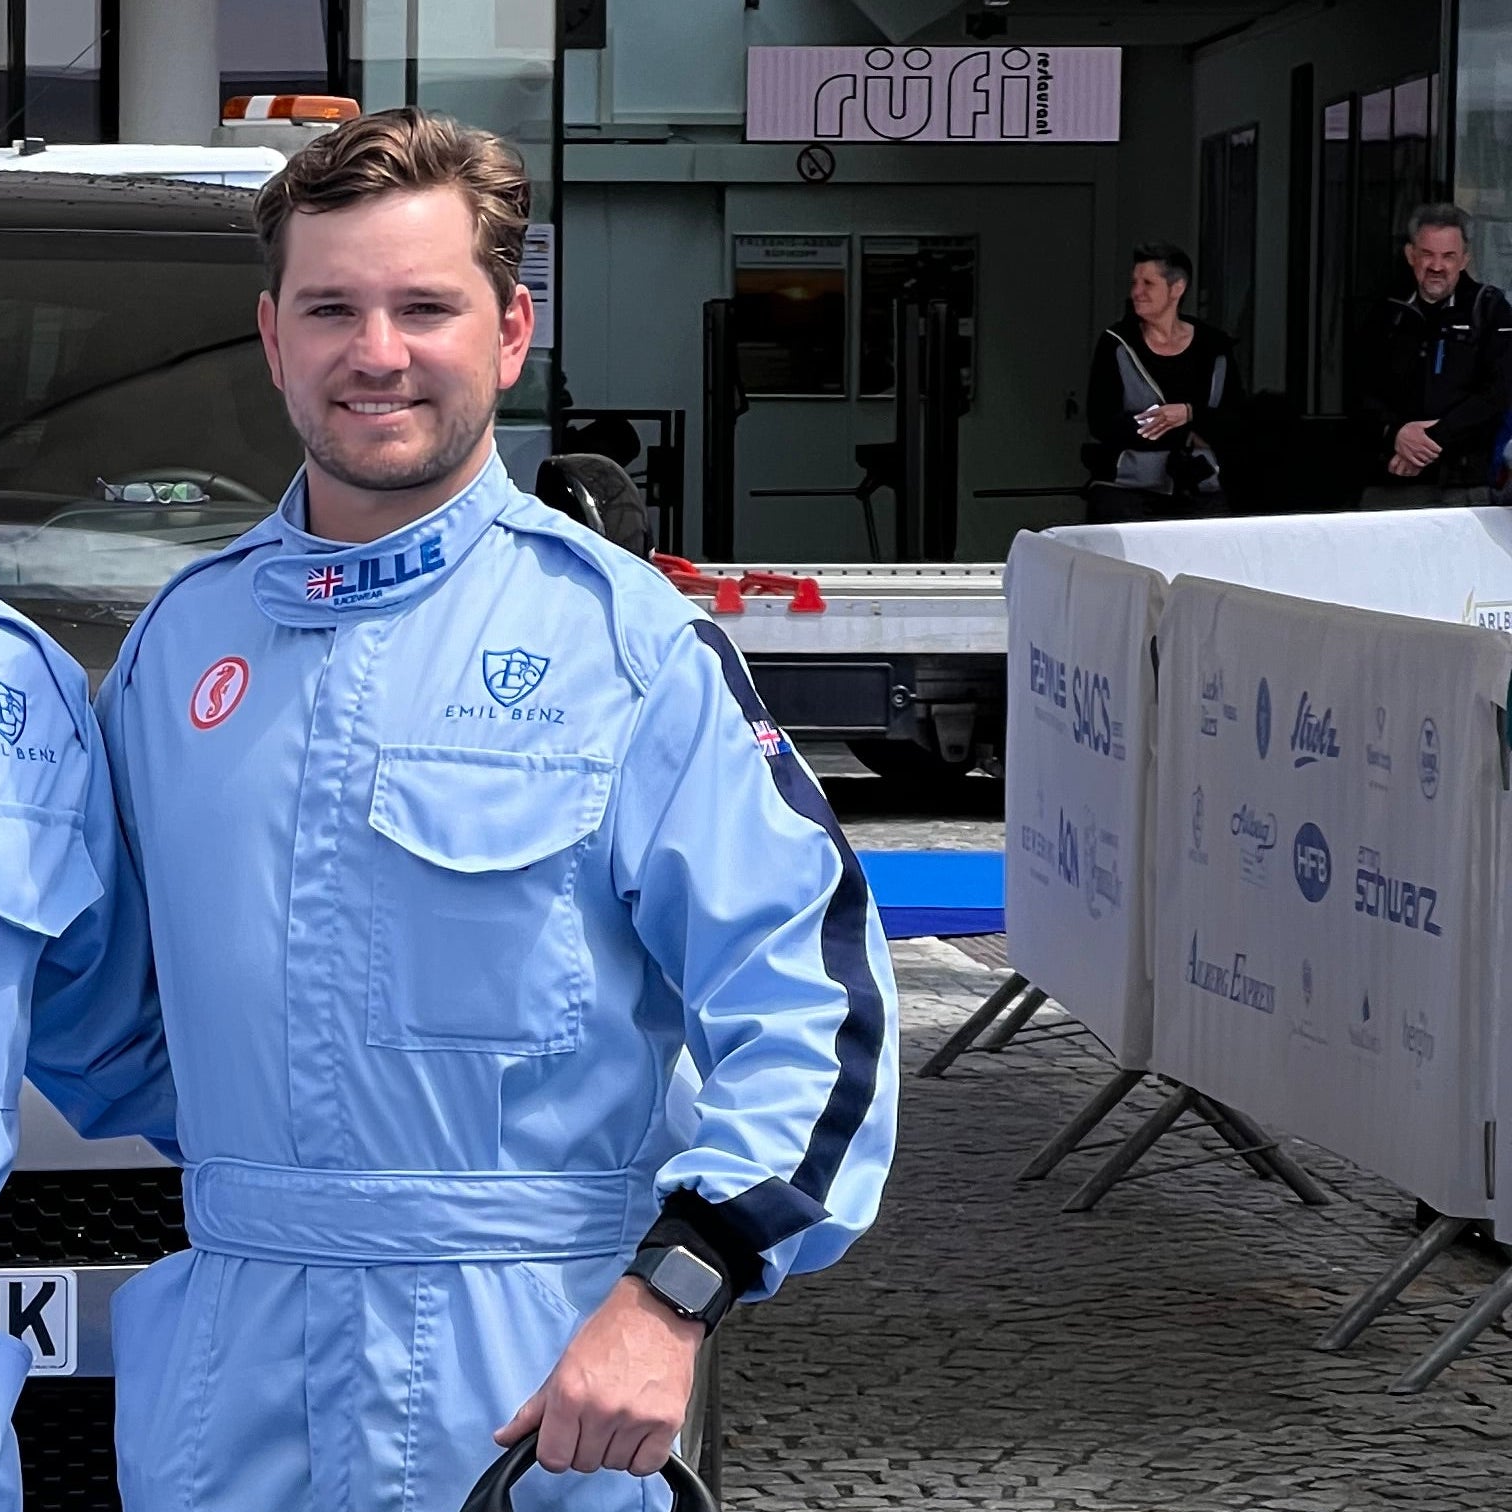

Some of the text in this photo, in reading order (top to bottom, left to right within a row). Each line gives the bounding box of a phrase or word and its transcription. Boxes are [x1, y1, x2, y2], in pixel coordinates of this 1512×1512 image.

[814, 47, 1030, 139] rüfi
[1036, 52, 1052, 135] restaurant
[333, 535, 447, 595] LILLE
[445, 704, 565, 724] EMIL BENZ
[1073, 666, 1110, 756] SACS
[16, 746, 57, 763] BENZ
[1058, 805, 1079, 889] AON
[1355, 866, 1443, 938] schwarz
